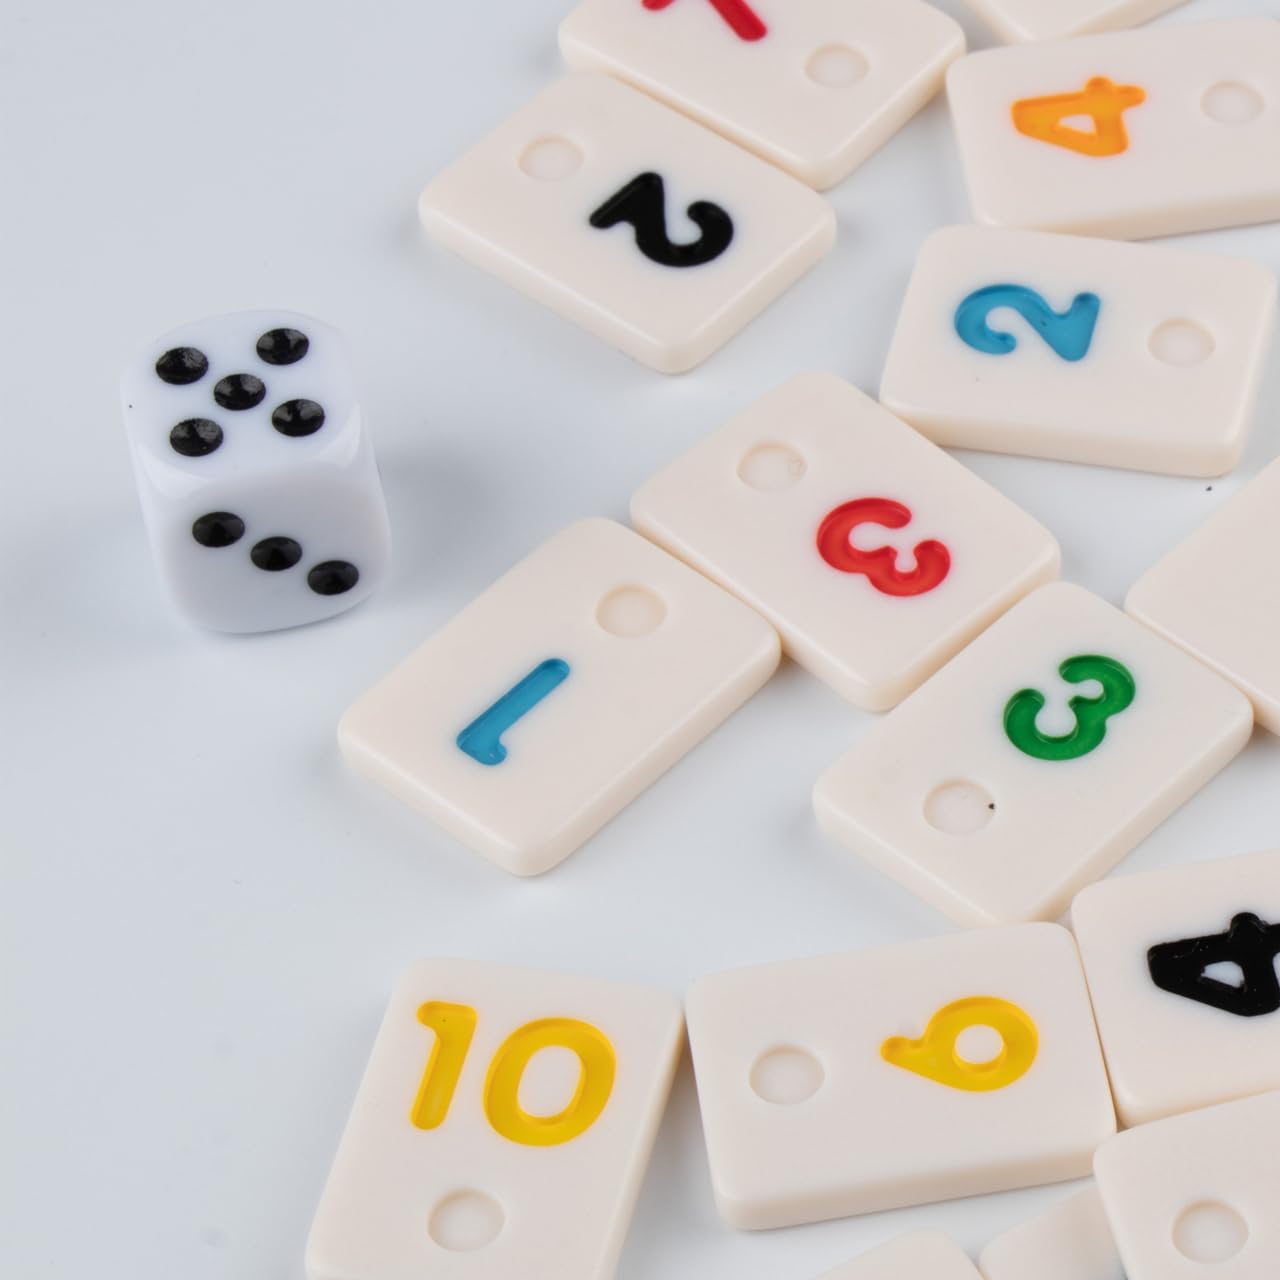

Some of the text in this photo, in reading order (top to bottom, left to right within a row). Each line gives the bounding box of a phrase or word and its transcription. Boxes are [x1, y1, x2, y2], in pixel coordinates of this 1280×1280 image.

[1010, 76, 1146, 157] 4
[590, 173, 733, 267] 2
[955, 284, 1100, 361] 2
[816, 497, 951, 597] 3
[457, 659, 570, 765] 1
[1004, 656, 1135, 760] 3
[409, 1000, 617, 1147] 10
